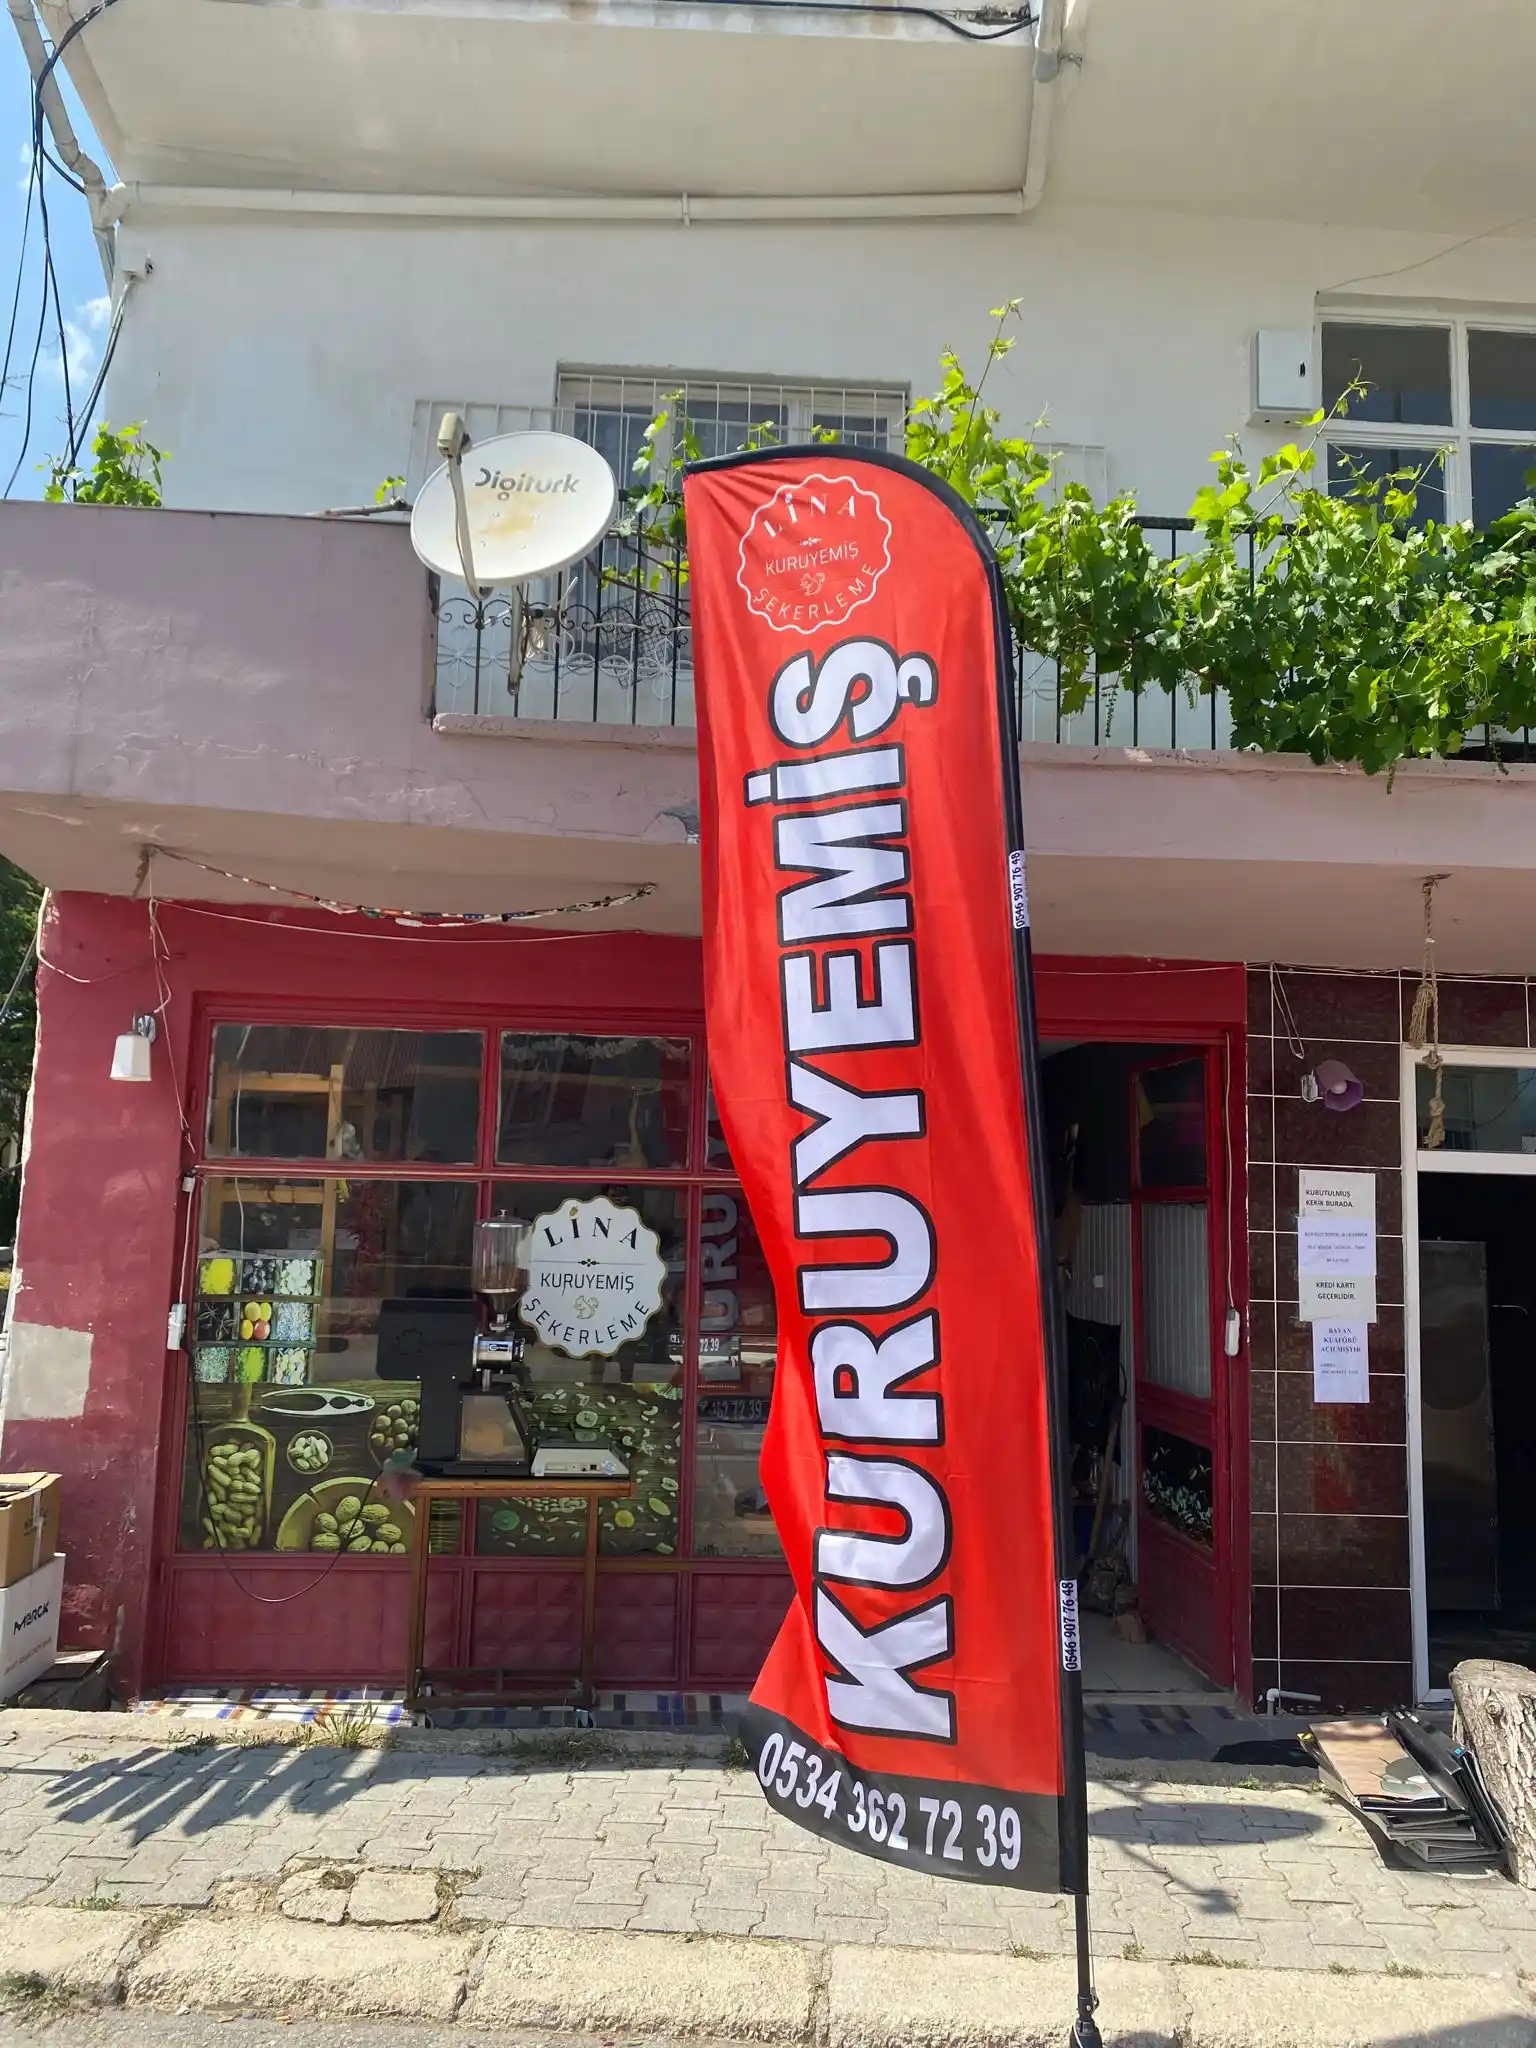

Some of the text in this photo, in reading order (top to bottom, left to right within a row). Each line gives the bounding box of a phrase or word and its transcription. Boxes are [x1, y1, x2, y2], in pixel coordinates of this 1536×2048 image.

[474, 467, 581, 501] Digiturk
[765, 541, 859, 577] KURUYEMİŞ
[753, 563, 878, 620] ŞEKERLEME
[1011, 852, 1025, 927] 0546 907 76 48
[744, 637, 957, 1745] KURUYEMİŞ
[1305, 1189, 1351, 1198] KURUTULMUŞ
[543, 1206, 638, 1250] LİNA
[540, 1271, 635, 1295] KURUYEMİŞ
[1316, 1280, 1355, 1289] KREDİ KARTI
[523, 1299, 651, 1345] ŞEKERLEME
[13, 1600, 50, 1635] MERCK
[1061, 1582, 1078, 1670] 0546 907 76 48
[758, 1732, 1021, 1870] 0534 362 72 39
